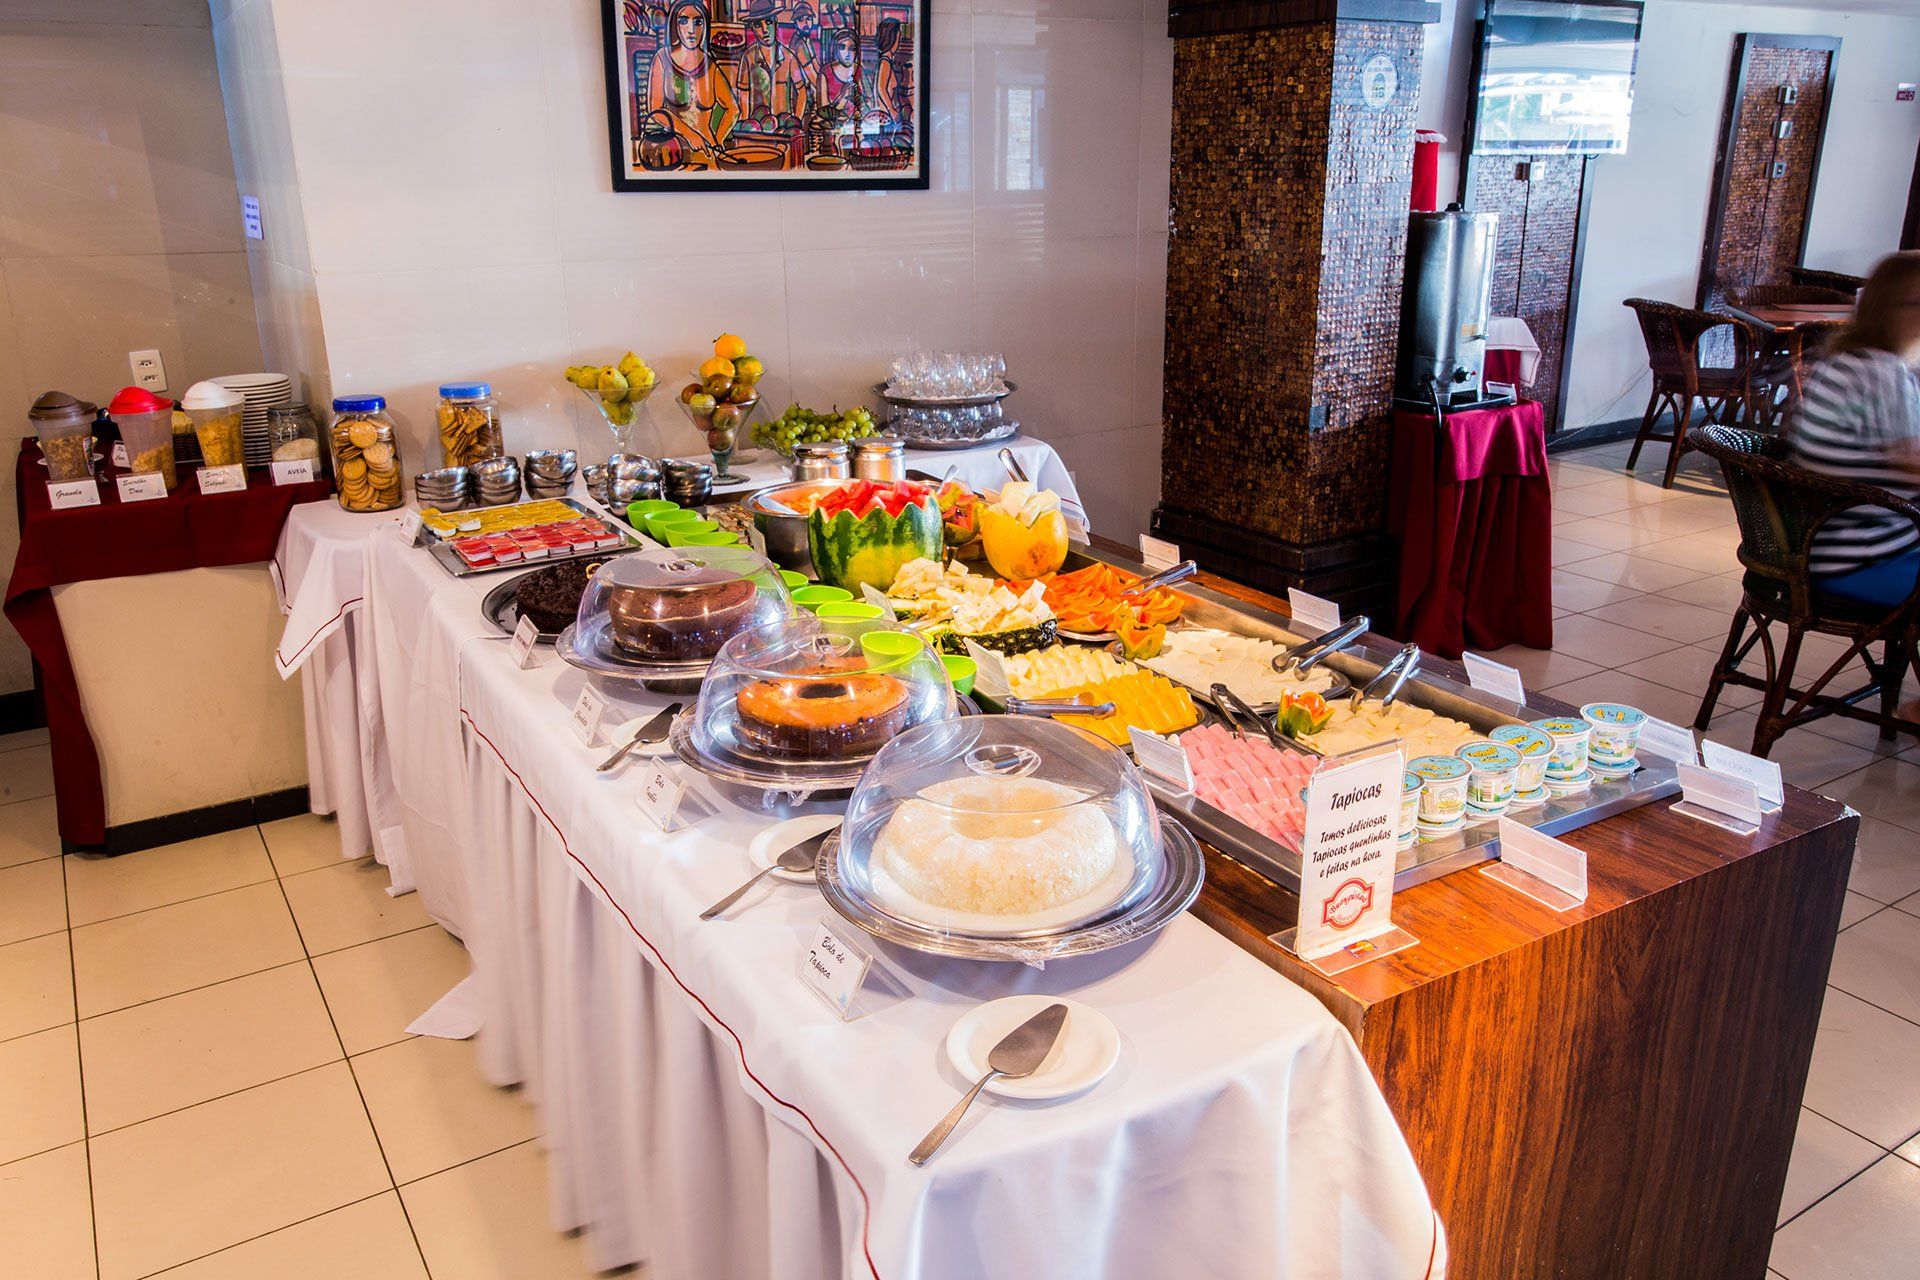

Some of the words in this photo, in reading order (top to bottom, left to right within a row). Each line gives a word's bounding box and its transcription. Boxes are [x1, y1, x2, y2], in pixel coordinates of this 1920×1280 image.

[287, 468, 307, 476] AVEIA
[56, 489, 83, 500] Granola
[1331, 783, 1382, 811] Tapiocas
[1320, 828, 1345, 844] Temos
[1347, 814, 1387, 835] deliciosas
[1312, 844, 1348, 864] Tapiocas
[1349, 829, 1392, 853] quentinhas
[1320, 869, 1325, 879] e
[1326, 861, 1349, 879] feitas
[1350, 857, 1361, 867] na
[821, 936, 836, 955] Bolo
[836, 953, 845, 964] de
[809, 950, 831, 979] Tapioca
